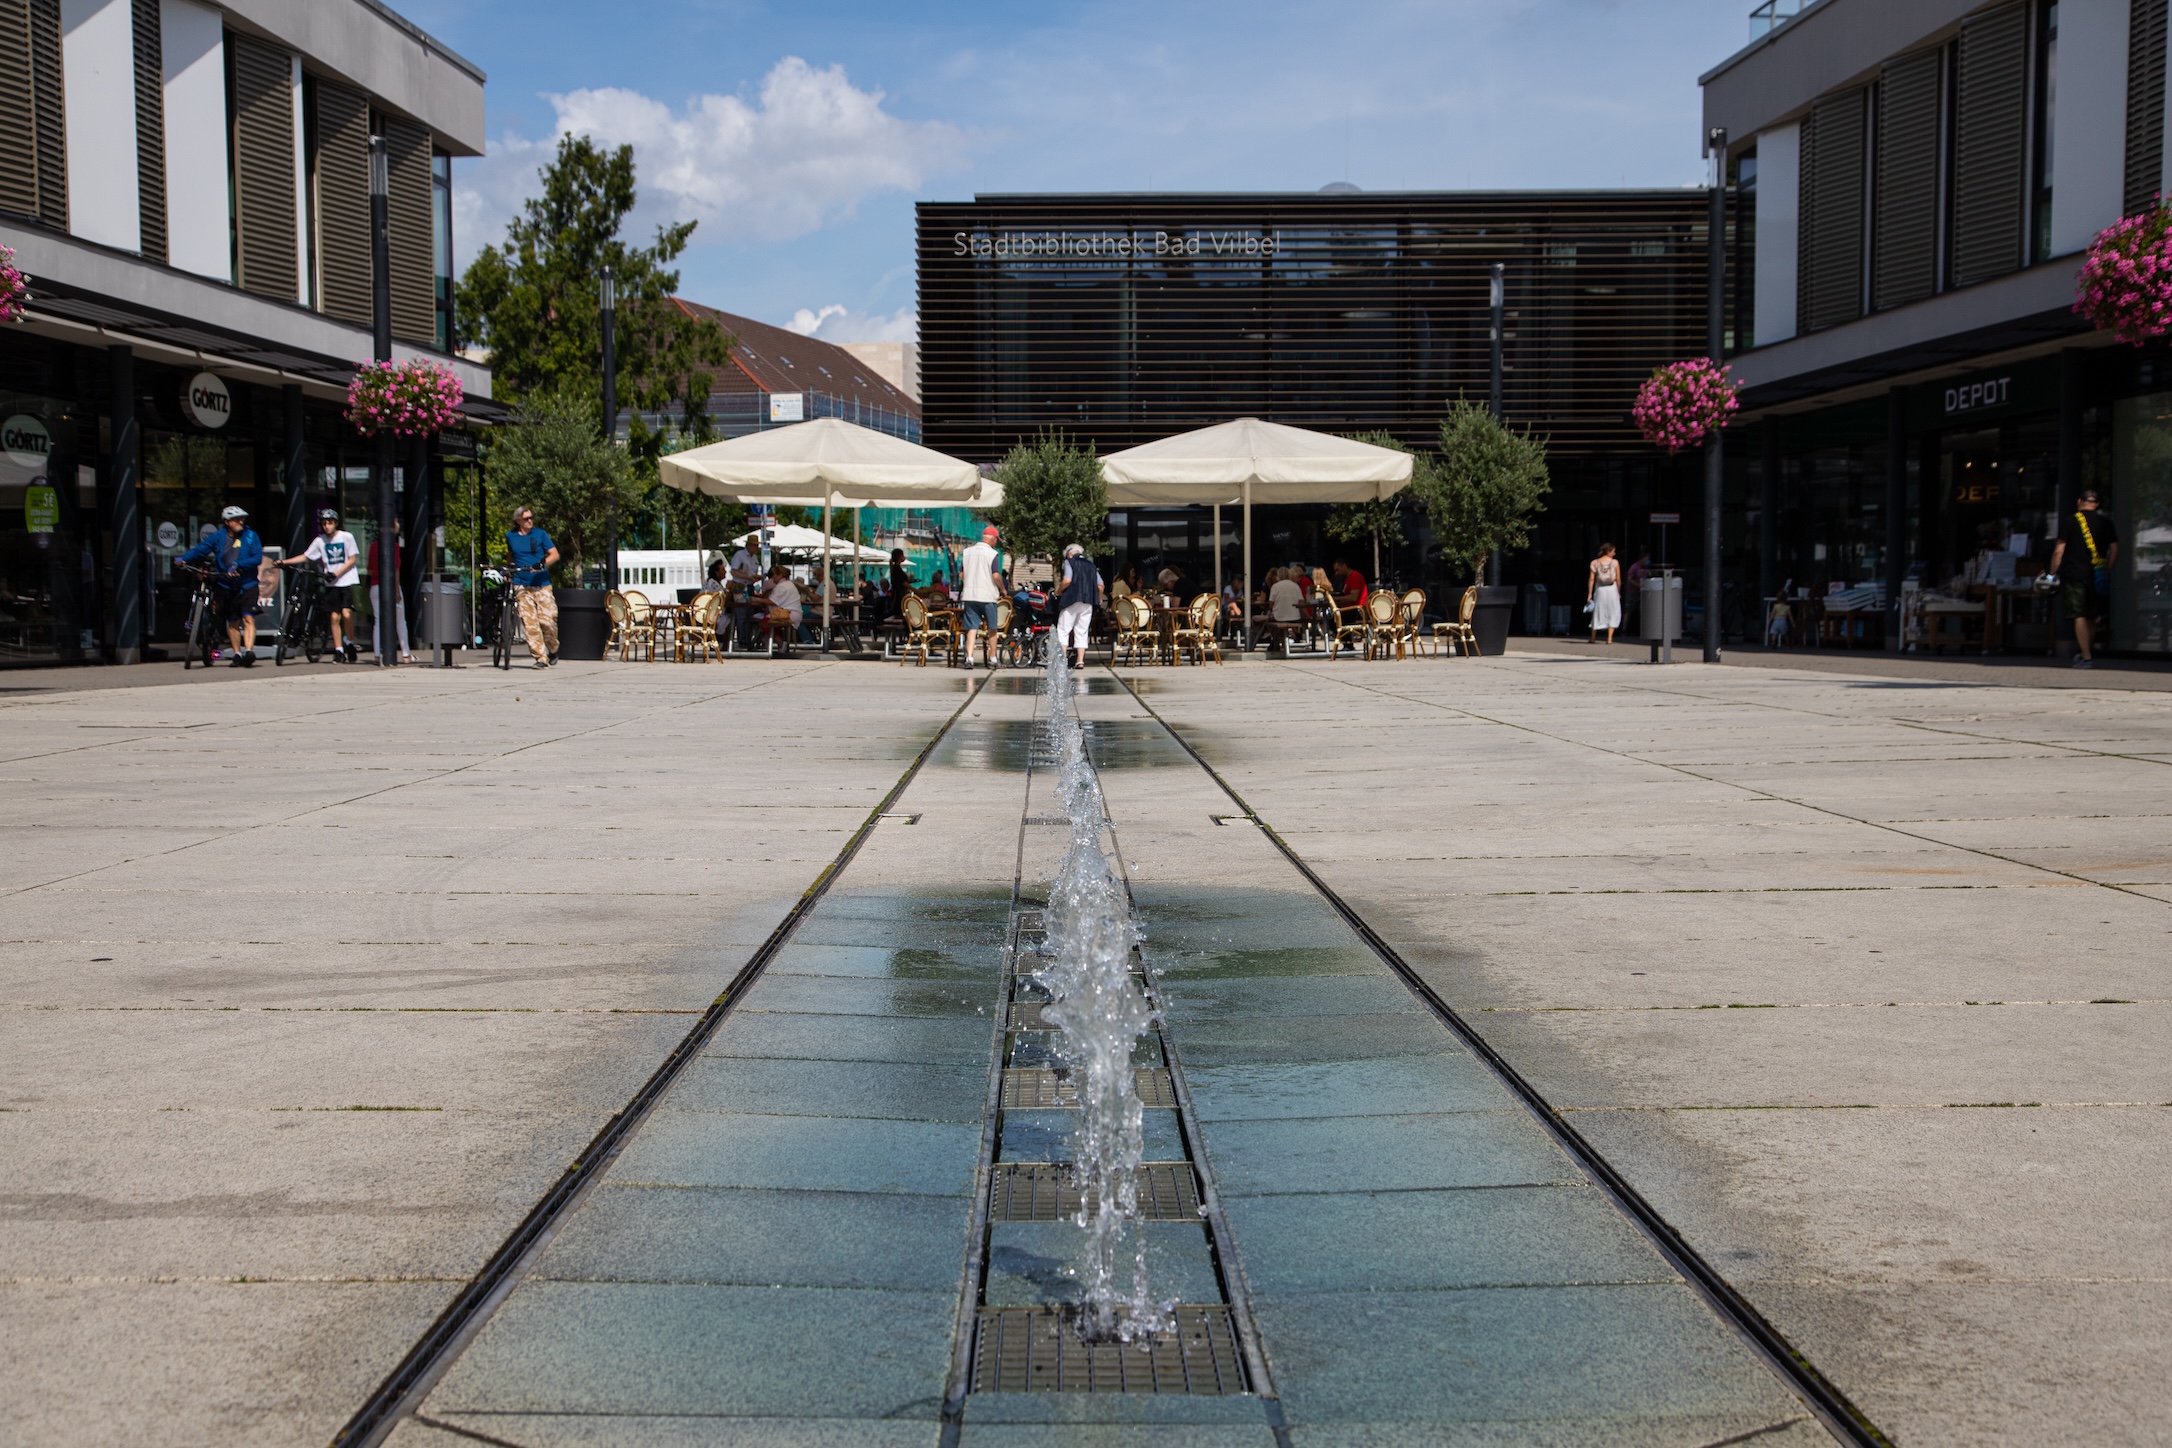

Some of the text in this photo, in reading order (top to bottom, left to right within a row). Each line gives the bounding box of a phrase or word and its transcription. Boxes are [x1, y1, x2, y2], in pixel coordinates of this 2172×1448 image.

[953, 230, 1281, 256] Stadtbibliothek Bad Vilbel
[1945, 377, 2011, 412] DEPOT
